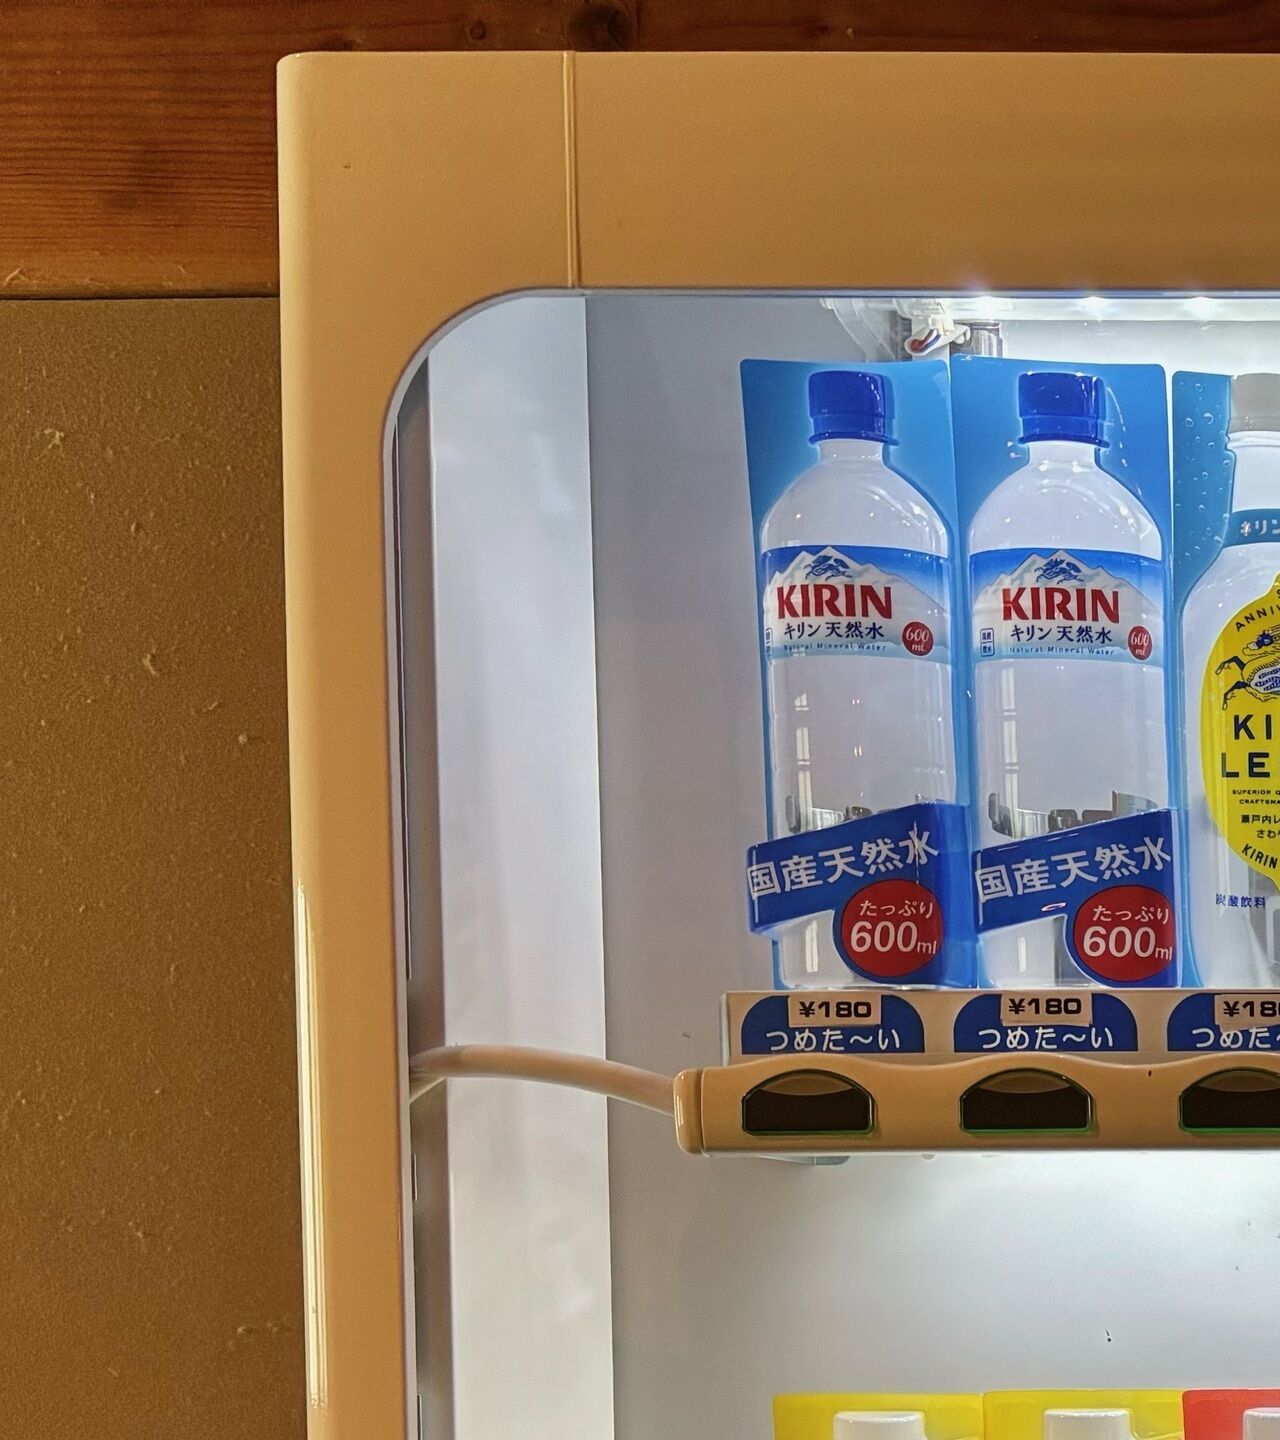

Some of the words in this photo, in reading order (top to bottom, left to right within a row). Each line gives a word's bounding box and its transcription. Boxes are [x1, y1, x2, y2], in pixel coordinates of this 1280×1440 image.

[777, 584, 892, 619] KIRIN
[1002, 587, 1119, 624] KIRIN
[746, 829, 939, 899] 国産天然水
[974, 836, 1171, 903] 国産天然水
[1242, 843, 1278, 871] KIRIN
[859, 900, 934, 917] たっぷり
[1216, 894, 1266, 909] 炭酸飲料
[850, 921, 937, 955] 600ml
[1082, 926, 1173, 961] 600ml
[799, 1000, 872, 1018] ¥180
[1008, 997, 1082, 1015] ¥180
